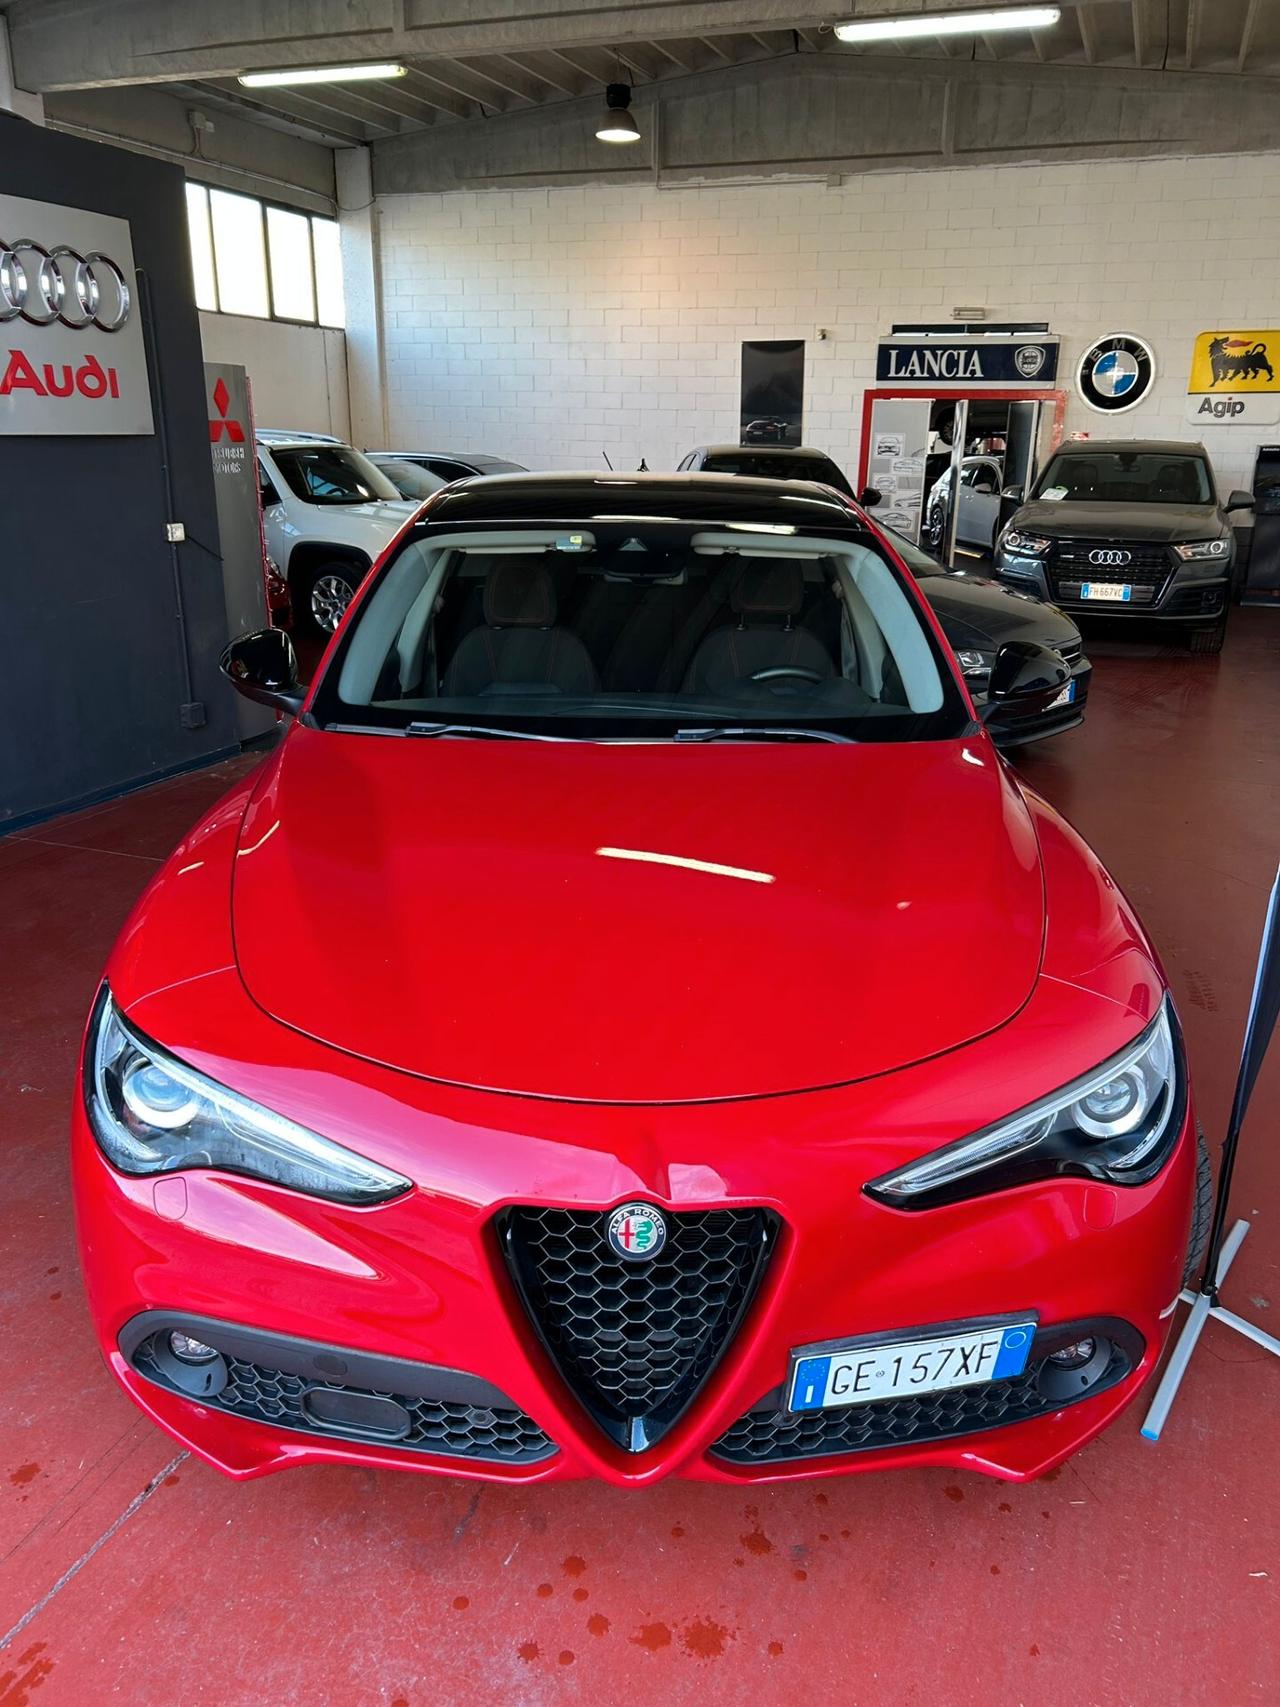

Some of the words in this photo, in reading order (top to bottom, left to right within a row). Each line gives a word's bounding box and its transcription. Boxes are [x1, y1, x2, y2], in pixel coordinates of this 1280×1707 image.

[887, 349, 984, 378] LANCIA
[1088, 338, 1148, 362] BMW
[0, 349, 120, 399] Audi
[1197, 396, 1245, 418] Agip
[611, 1211, 631, 1235] ALFA
[634, 1208, 664, 1236] ROMEO
[831, 1360, 876, 1395] GE
[891, 1340, 999, 1387] 157XF
